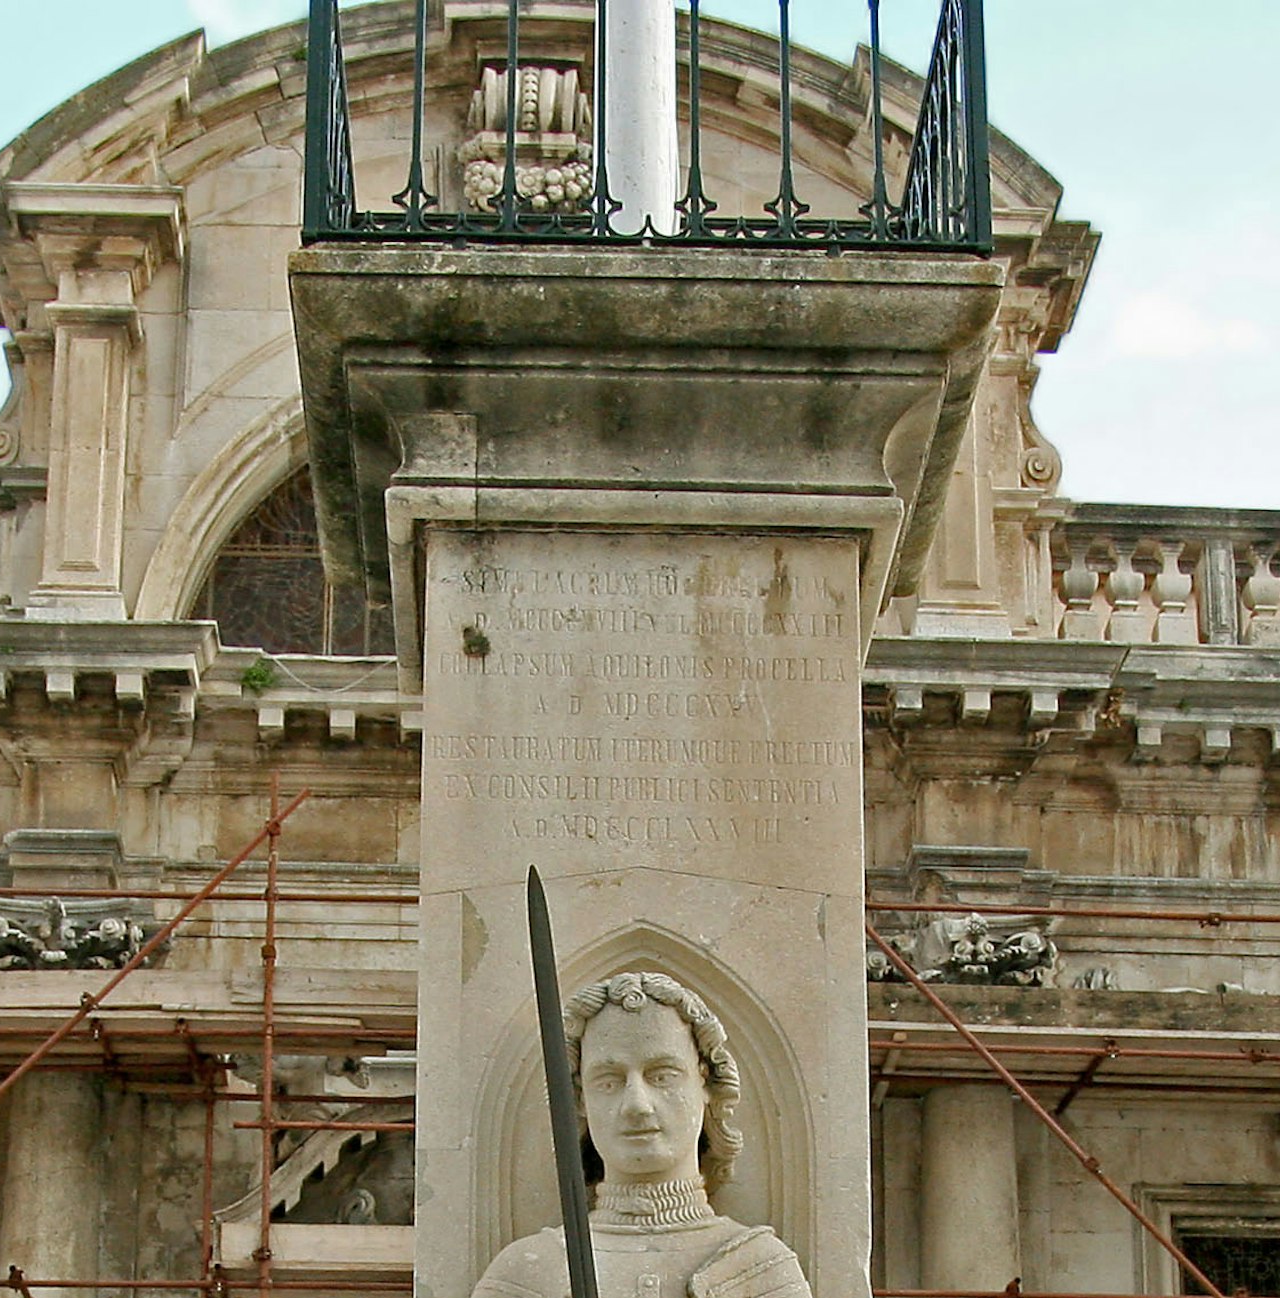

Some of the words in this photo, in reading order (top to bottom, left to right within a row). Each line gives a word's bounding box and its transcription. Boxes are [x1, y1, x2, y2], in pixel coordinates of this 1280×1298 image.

[438, 652, 574, 677] COLLAPSUM
[586, 653, 714, 680] AQUILONIS
[722, 656, 847, 682] PROCELLA
[431, 735, 602, 762] RESTAURATUM
[611, 737, 741, 768] ITERUMQUE
[748, 738, 856, 767] ERECTUM
[445, 773, 479, 799] EX
[487, 774, 600, 801] CONSILII
[609, 775, 699, 803] PUBLICI
[707, 777, 840, 805] SENTENTIA
